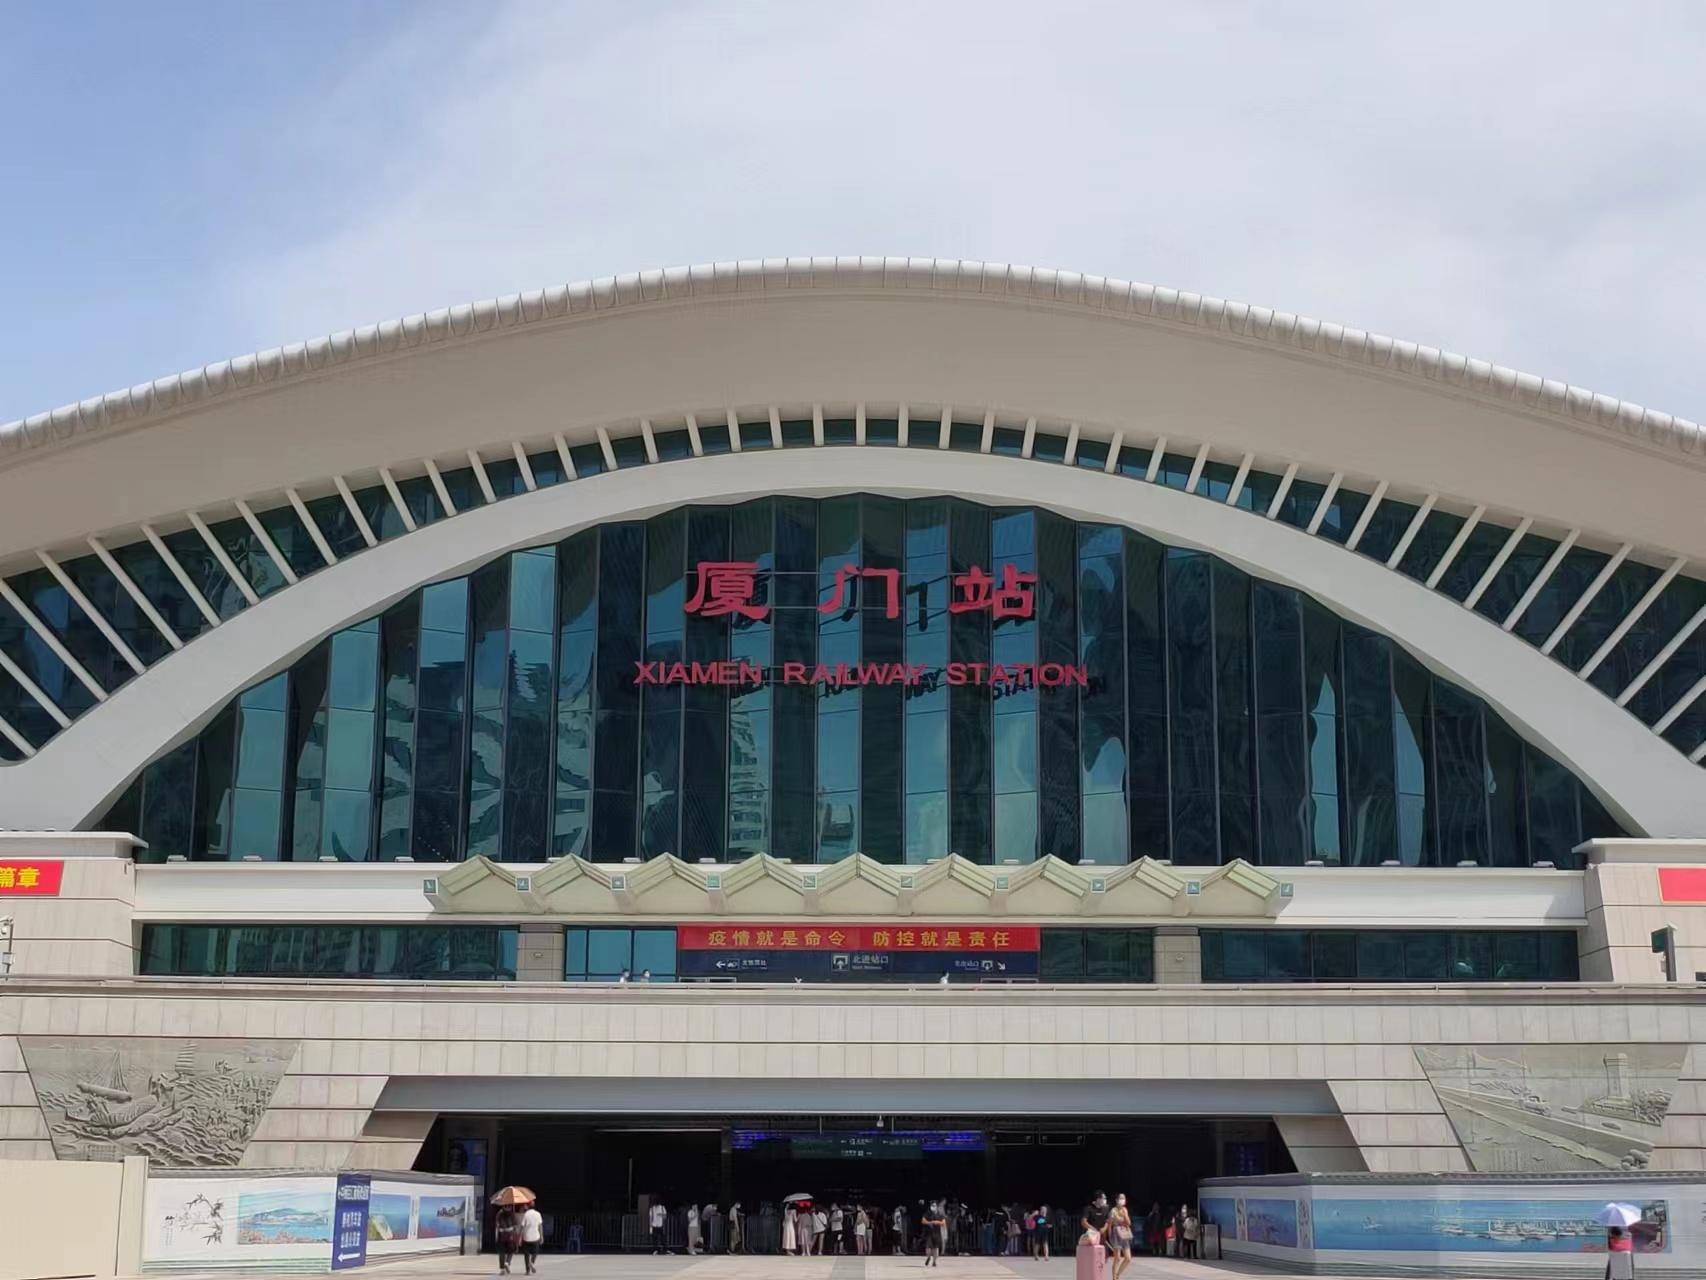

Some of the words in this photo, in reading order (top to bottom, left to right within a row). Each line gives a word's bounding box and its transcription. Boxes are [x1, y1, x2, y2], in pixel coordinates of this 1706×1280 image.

[683, 561, 1039, 619] 厦门站
[633, 661, 763, 686] XIAMEN
[783, 661, 928, 687] RAILWAY
[946, 661, 1089, 687] STATION
[708, 930, 846, 947] 疫情就是命令
[872, 930, 1010, 947] 防控就是责任
